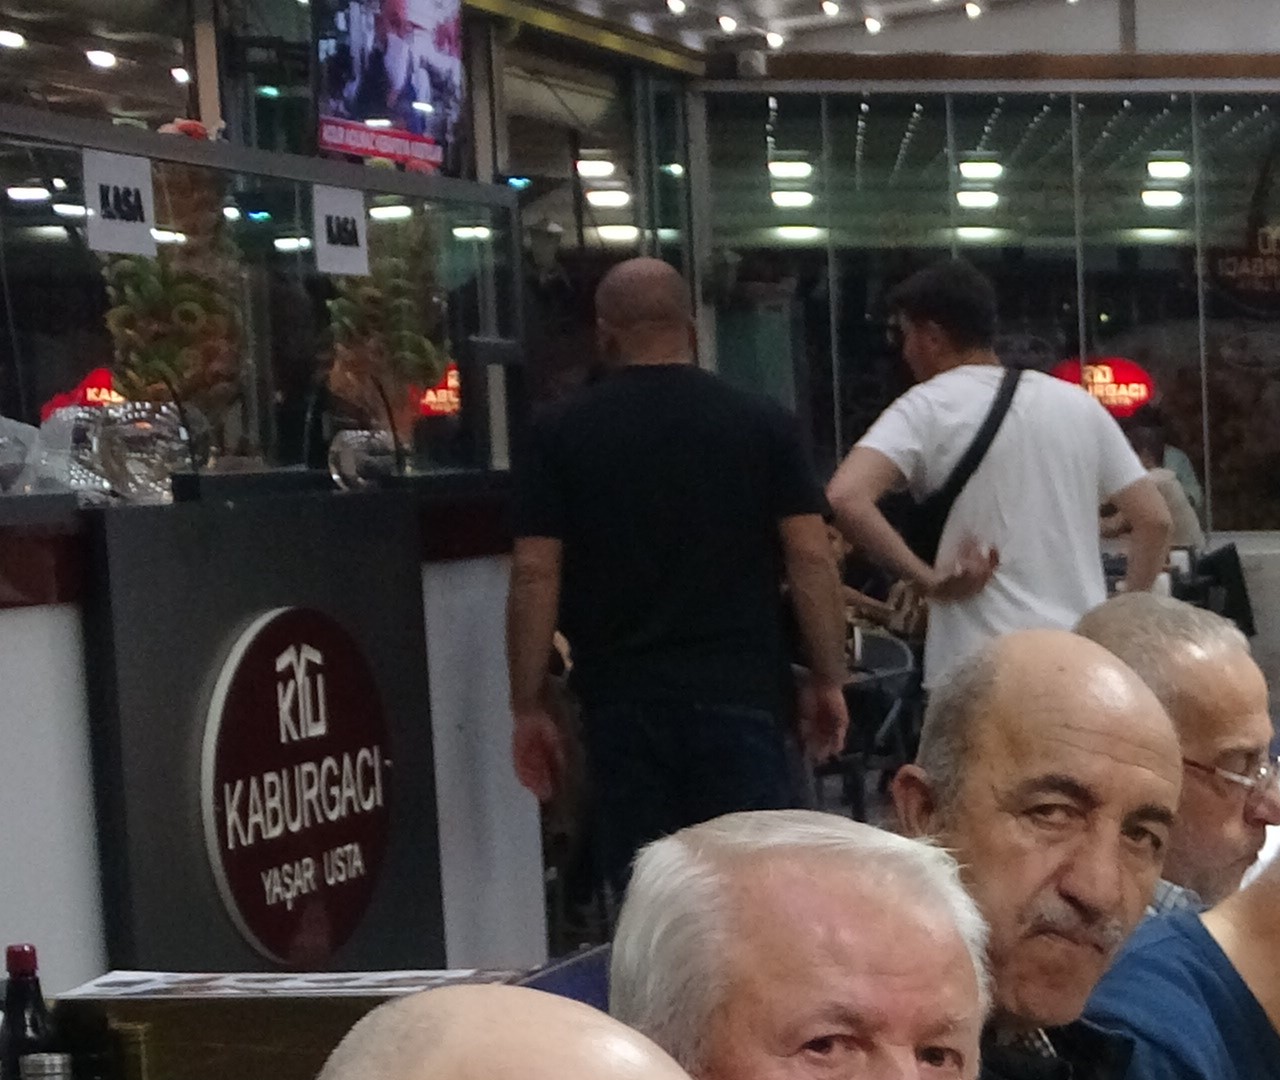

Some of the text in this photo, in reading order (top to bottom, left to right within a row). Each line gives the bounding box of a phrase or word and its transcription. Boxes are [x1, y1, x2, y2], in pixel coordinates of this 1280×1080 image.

[99, 183, 146, 223] KASA
[324, 213, 360, 247] KASA
[223, 745, 385, 850] KABURGACI
[260, 842, 367, 911] YAŞAR USTA
